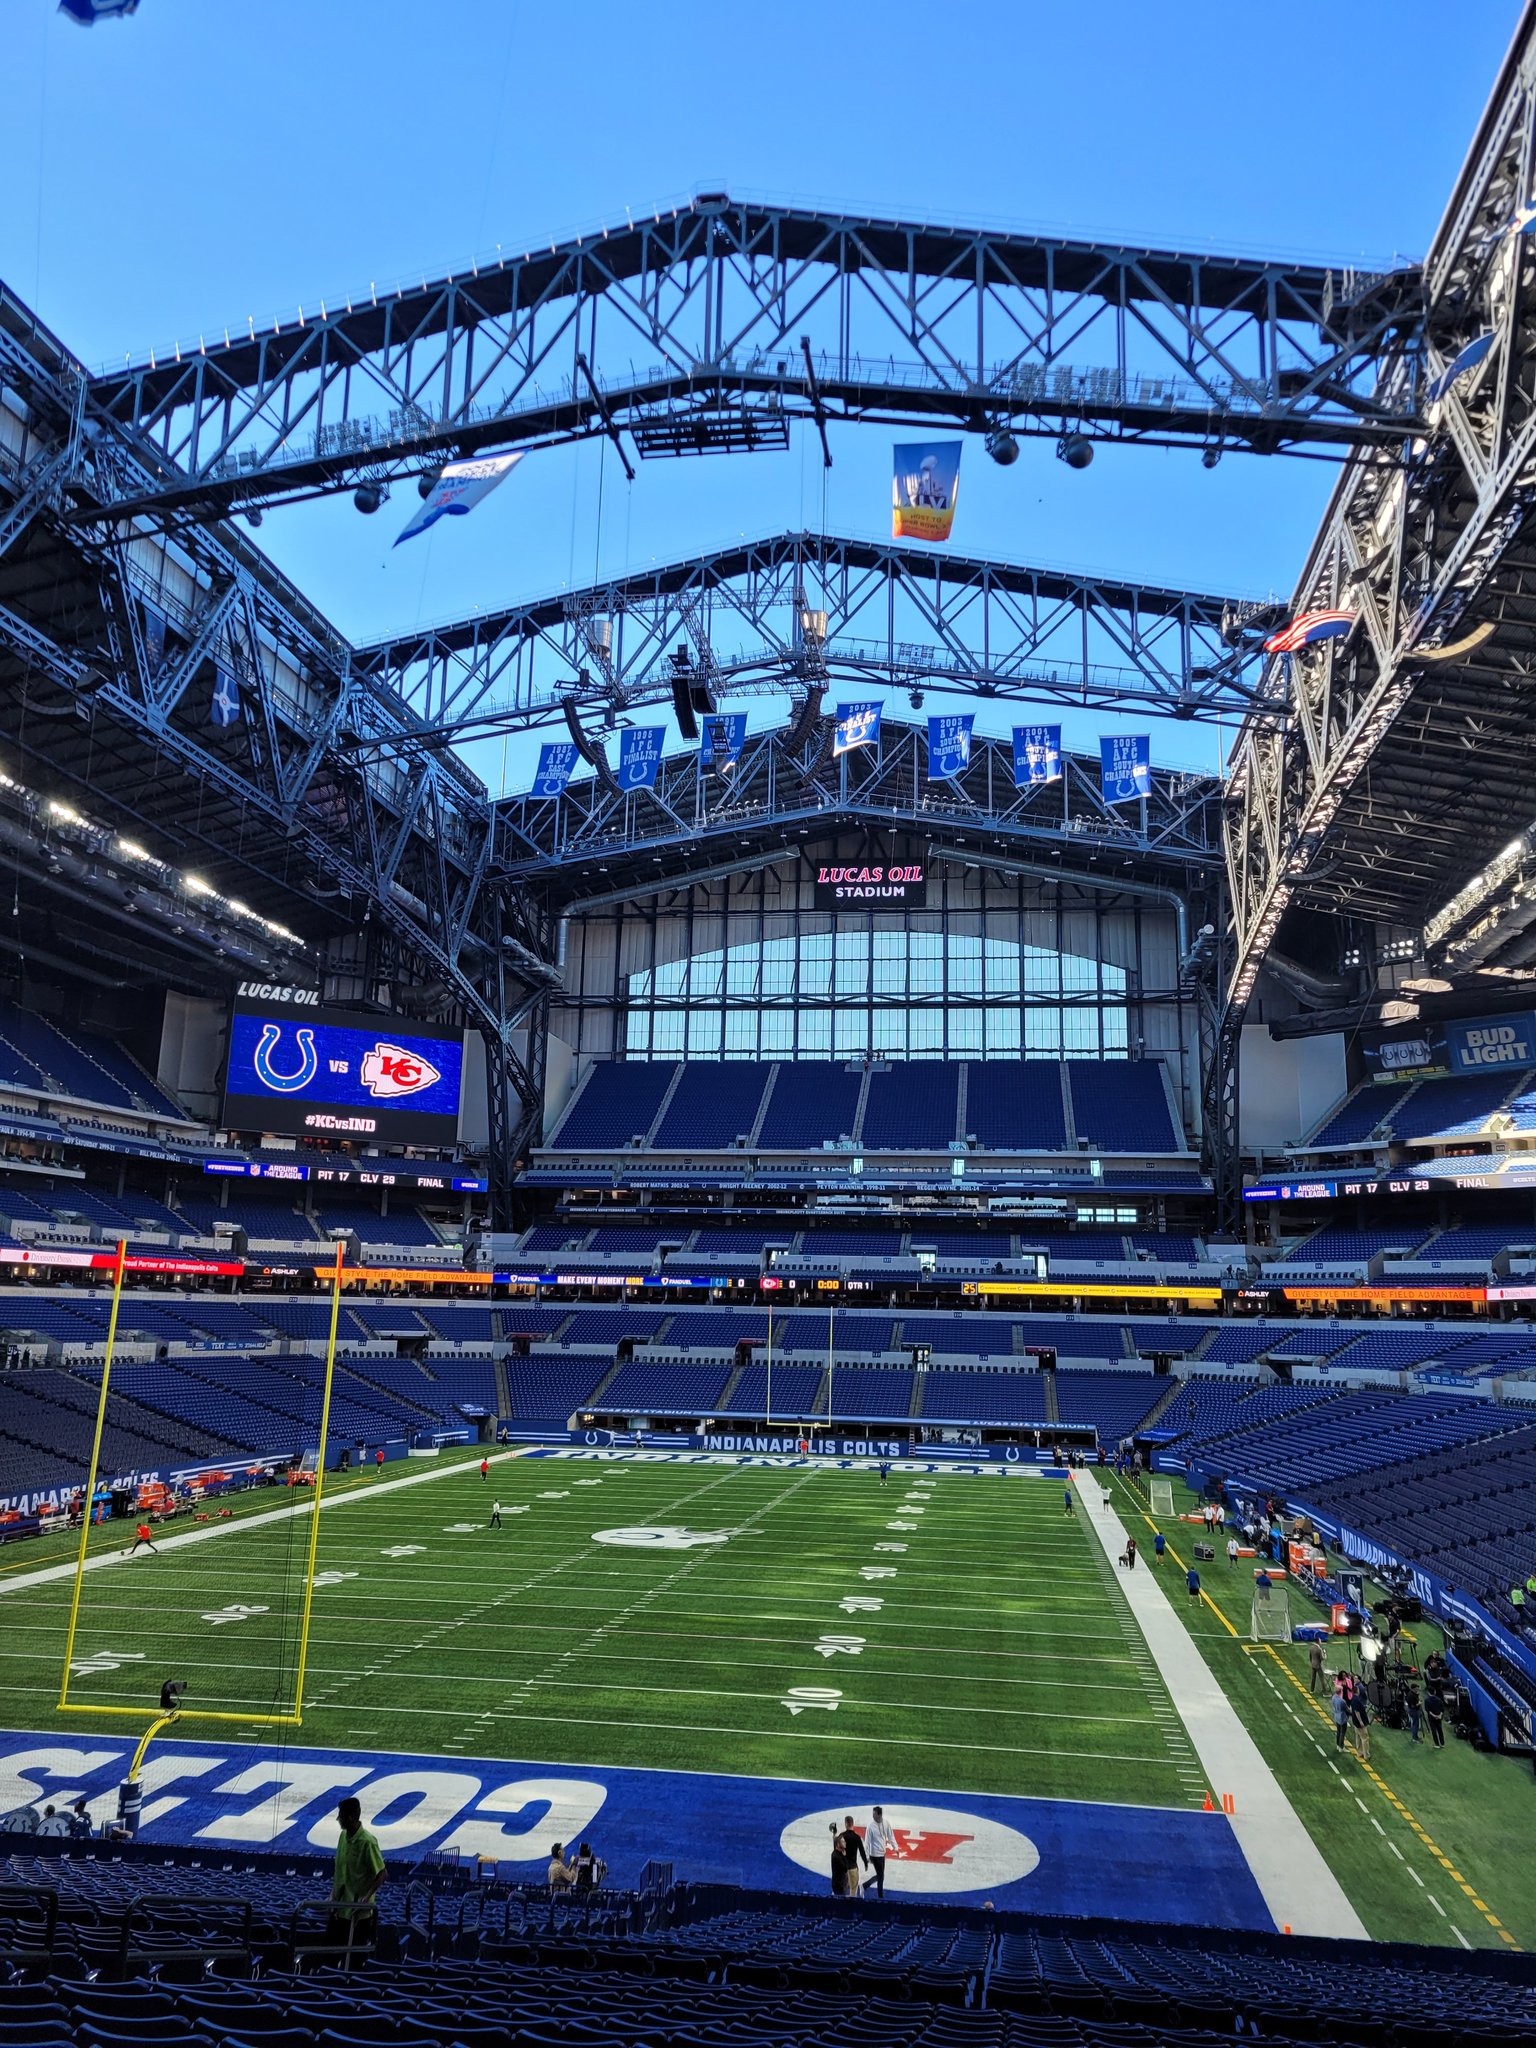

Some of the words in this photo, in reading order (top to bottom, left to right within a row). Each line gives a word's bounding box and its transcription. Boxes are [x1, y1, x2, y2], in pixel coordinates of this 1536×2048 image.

[633, 730, 653, 740] 1995
[1025, 735, 1050, 746] AFC
[629, 739, 653, 753] AFC
[1113, 738, 1137, 747] 2005
[546, 752, 572, 764] AFC
[623, 751, 659, 765] FINALIST
[1113, 747, 1138, 761] AFC
[1113, 761, 1138, 771] SOUTH
[818, 867, 883, 883] LUCAS
[888, 866, 923, 882] OIL
[835, 886, 905, 897] STADIUM
[237, 981, 293, 1002] LUCAS
[294, 988, 320, 1006] OIL
[1466, 1026, 1516, 1049] BUD
[1460, 1043, 1528, 1065] LIGHT
[268, 1165, 299, 1173] AROUND
[275, 1171, 302, 1180] LEAGUE
[318, 1170, 334, 1180] PIT
[338, 1172, 350, 1181] 17
[360, 1173, 379, 1184] CLV
[383, 1175, 396, 1185] 29
[418, 1177, 444, 1188] FINAL
[1345, 1185, 1361, 1194] PIT
[1366, 1183, 1378, 1193] 17
[1390, 1182, 1410, 1192] CLV
[1414, 1181, 1430, 1191] 29
[1456, 1178, 1489, 1188] FINAL
[1305, 1190, 1330, 1198] LEAGUE
[138, 1261, 158, 1269] Partner
[166, 1262, 175, 1270] The
[175, 1264, 205, 1272] Indianapolis
[416, 1272, 437, 1280] FIELD
[440, 1273, 483, 1281] ADVANTAGE
[557, 1276, 576, 1284] MAKE
[576, 1276, 596, 1285] EVERY
[597, 1277, 625, 1285] MOMENT
[626, 1277, 644, 1285] MORE
[738, 1278, 745, 1287] 0
[789, 1280, 796, 1289] 0
[817, 1280, 839, 1290] 0:00
[848, 1281, 863, 1290] QTR
[865, 1281, 869, 1290] 1
[963, 1283, 976, 1294] 25
[1292, 1291, 1311, 1299] GIVE
[1313, 1291, 1339, 1299] STYLE
[1342, 1291, 1358, 1299] THE
[1361, 1291, 1383, 1299] HOME
[1389, 1291, 1415, 1299] FIELD
[1418, 1291, 1472, 1299] ADVANTAGE
[843, 1441, 900, 1456] COLTS
[838, 1596, 885, 1612] 30
[201, 1604, 270, 1624] 20
[814, 1635, 867, 1656] 20
[69, 1651, 147, 1676] 10
[781, 1687, 843, 1713] 10
